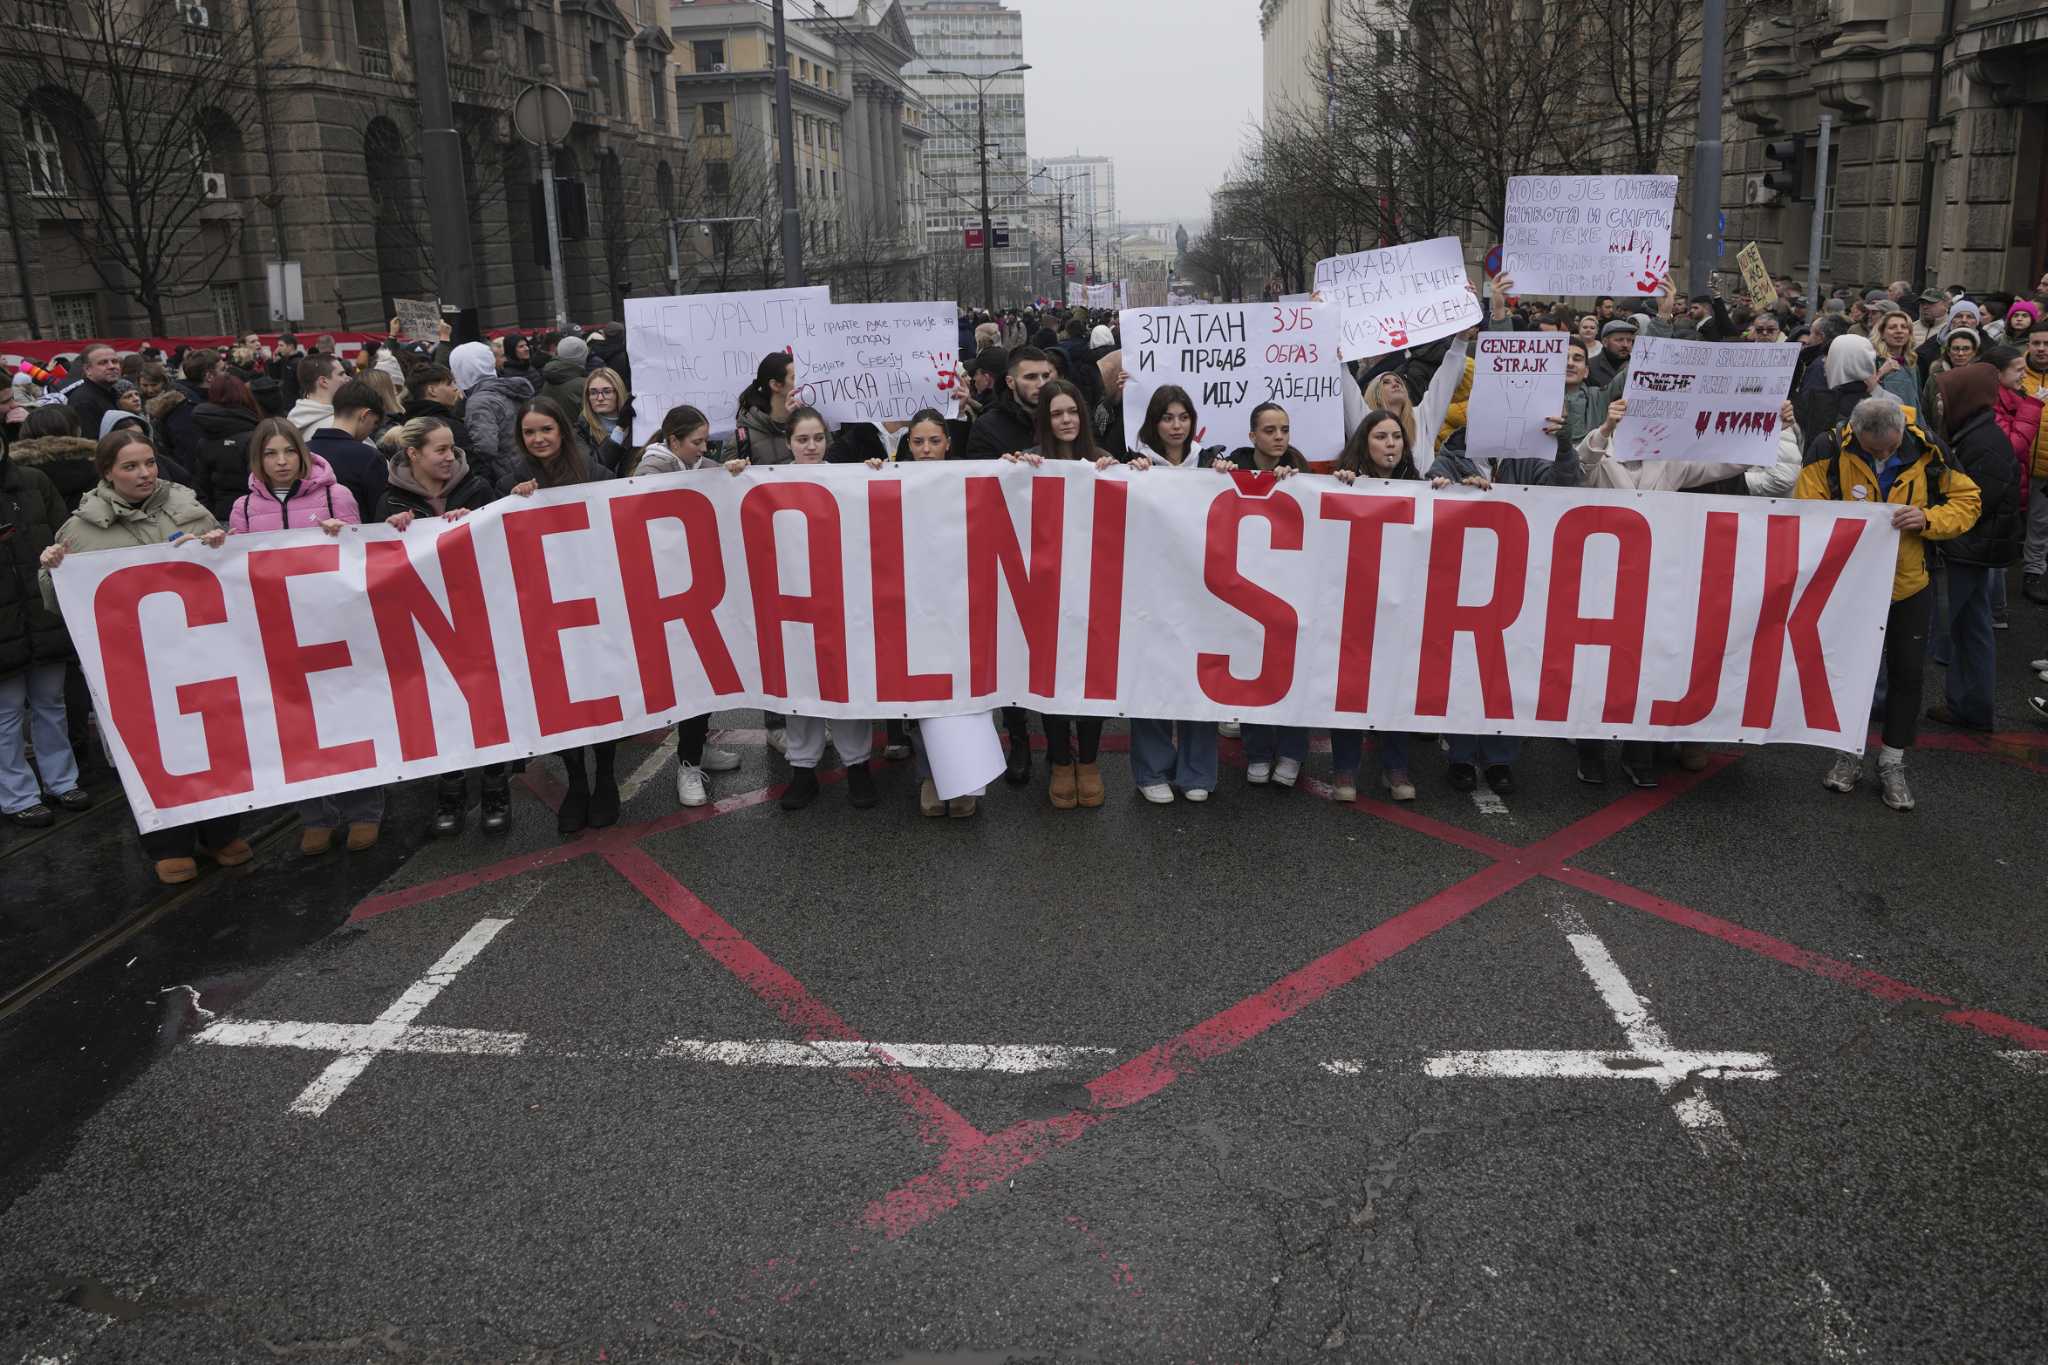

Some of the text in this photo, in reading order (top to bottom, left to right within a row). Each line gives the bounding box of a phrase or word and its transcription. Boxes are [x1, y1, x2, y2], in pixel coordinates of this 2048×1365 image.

[1506, 206, 1671, 231] ЖИВОТА И СМРТИ,
[1551, 227, 1601, 246] РЕКЕ
[1608, 229, 1653, 254] КРВИ
[1317, 247, 1416, 287] ДРЖАВИ
[1322, 264, 1462, 308] ТРЕБА ЛЕЧЕЊЕ
[640, 304, 682, 347] НЕ
[1139, 306, 1313, 345] ЗЛАТАН ЗУБ
[1139, 343, 1319, 374] И ПРЉАВ ОБРАЗ
[1480, 338, 1565, 354] GENERALNI
[664, 355, 709, 382] НАС
[1493, 354, 1550, 373] ŠTRAJK
[800, 368, 914, 408] ОТИСКА НА
[1203, 372, 1343, 407] ИДУ ЗАЈЕДНО
[1695, 411, 1713, 440] U
[1715, 411, 1780, 441] KVARU
[94, 469, 1866, 808] GENERALNI ŠTRAJK
